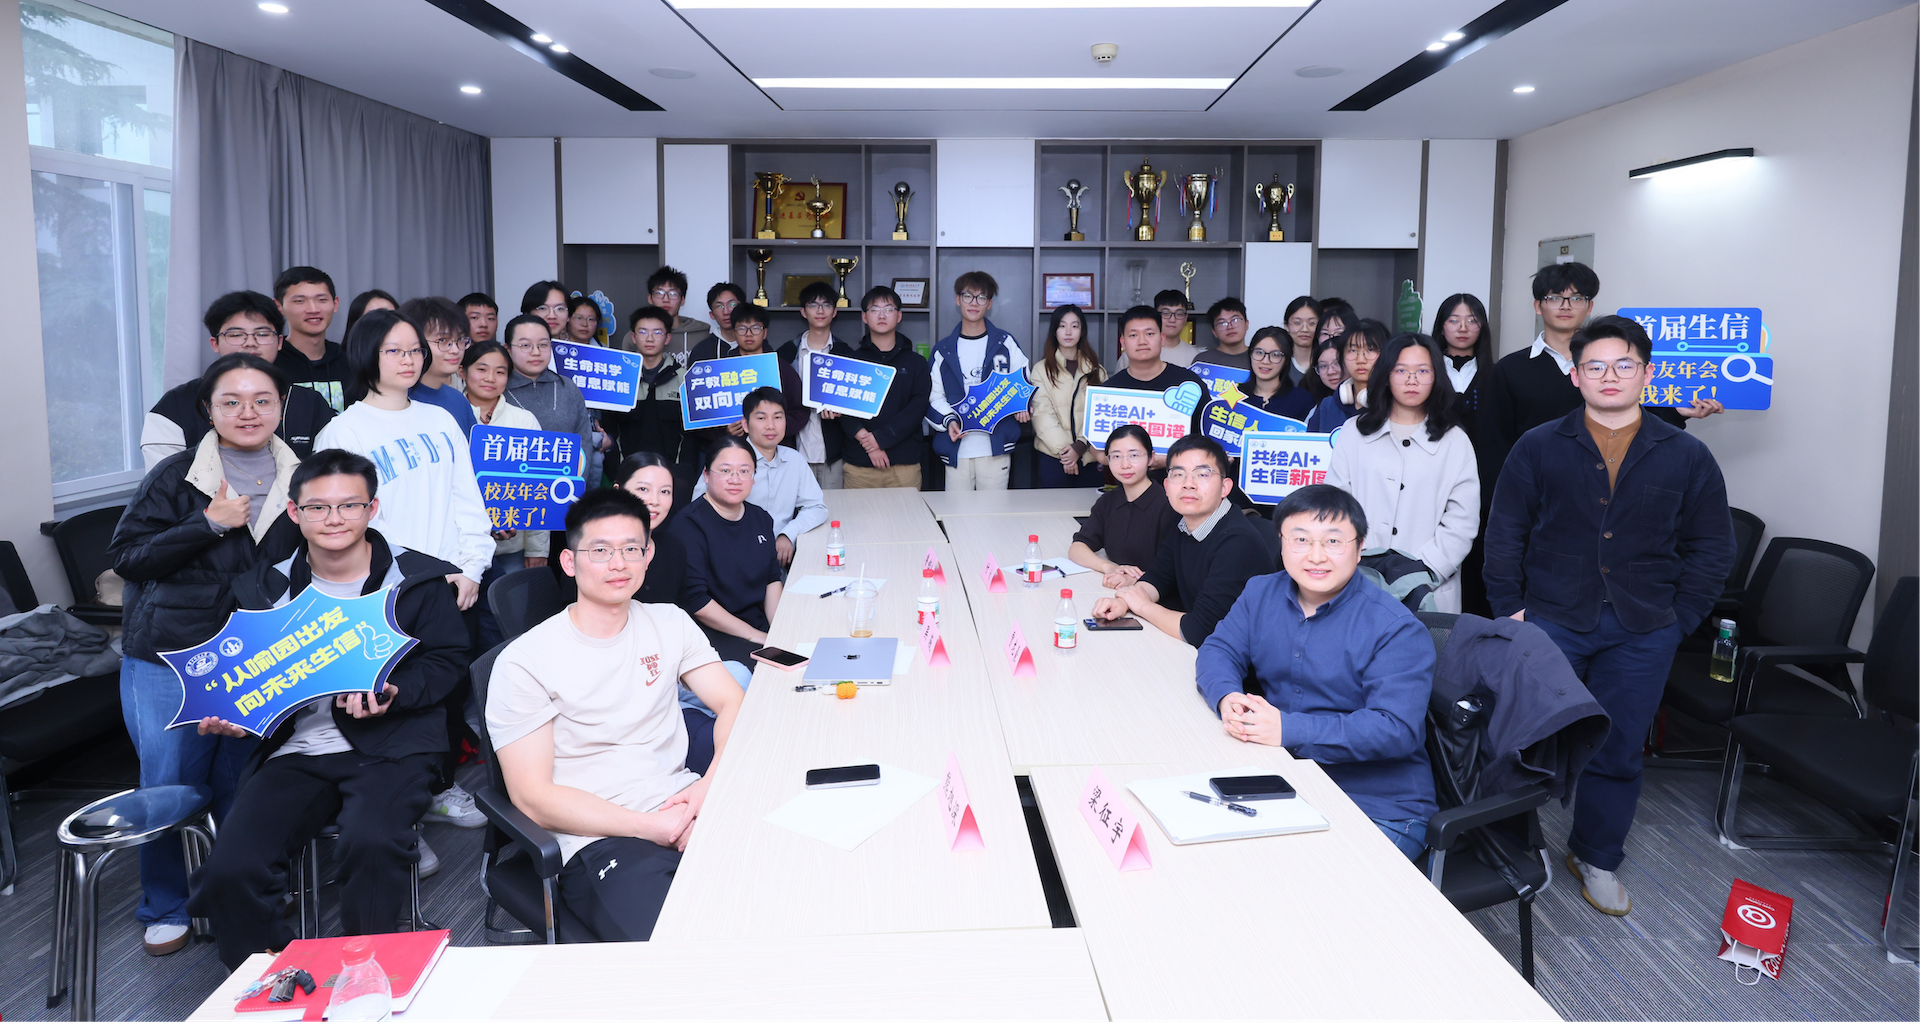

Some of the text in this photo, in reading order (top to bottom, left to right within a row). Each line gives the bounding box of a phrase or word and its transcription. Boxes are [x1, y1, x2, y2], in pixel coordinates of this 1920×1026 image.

[1635, 313, 1750, 341] 首届生信
[563, 357, 622, 377] 生命科学
[816, 366, 873, 387] 生命科学
[1650, 361, 1719, 379] 友年会
[572, 374, 630, 394] 信息赋能
[690, 368, 758, 391] 产教融合
[821, 381, 878, 403] 信息赋能
[1094, 403, 1156, 420] 共绘AI+
[1209, 423, 1242, 448] 回家
[482, 434, 574, 464] 首届生信
[1251, 450, 1321, 468] 共绘AI+
[484, 482, 549, 502] 校友年会
[486, 506, 546, 528] 我来了!
[1088, 785, 1124, 844] 梁征宇
